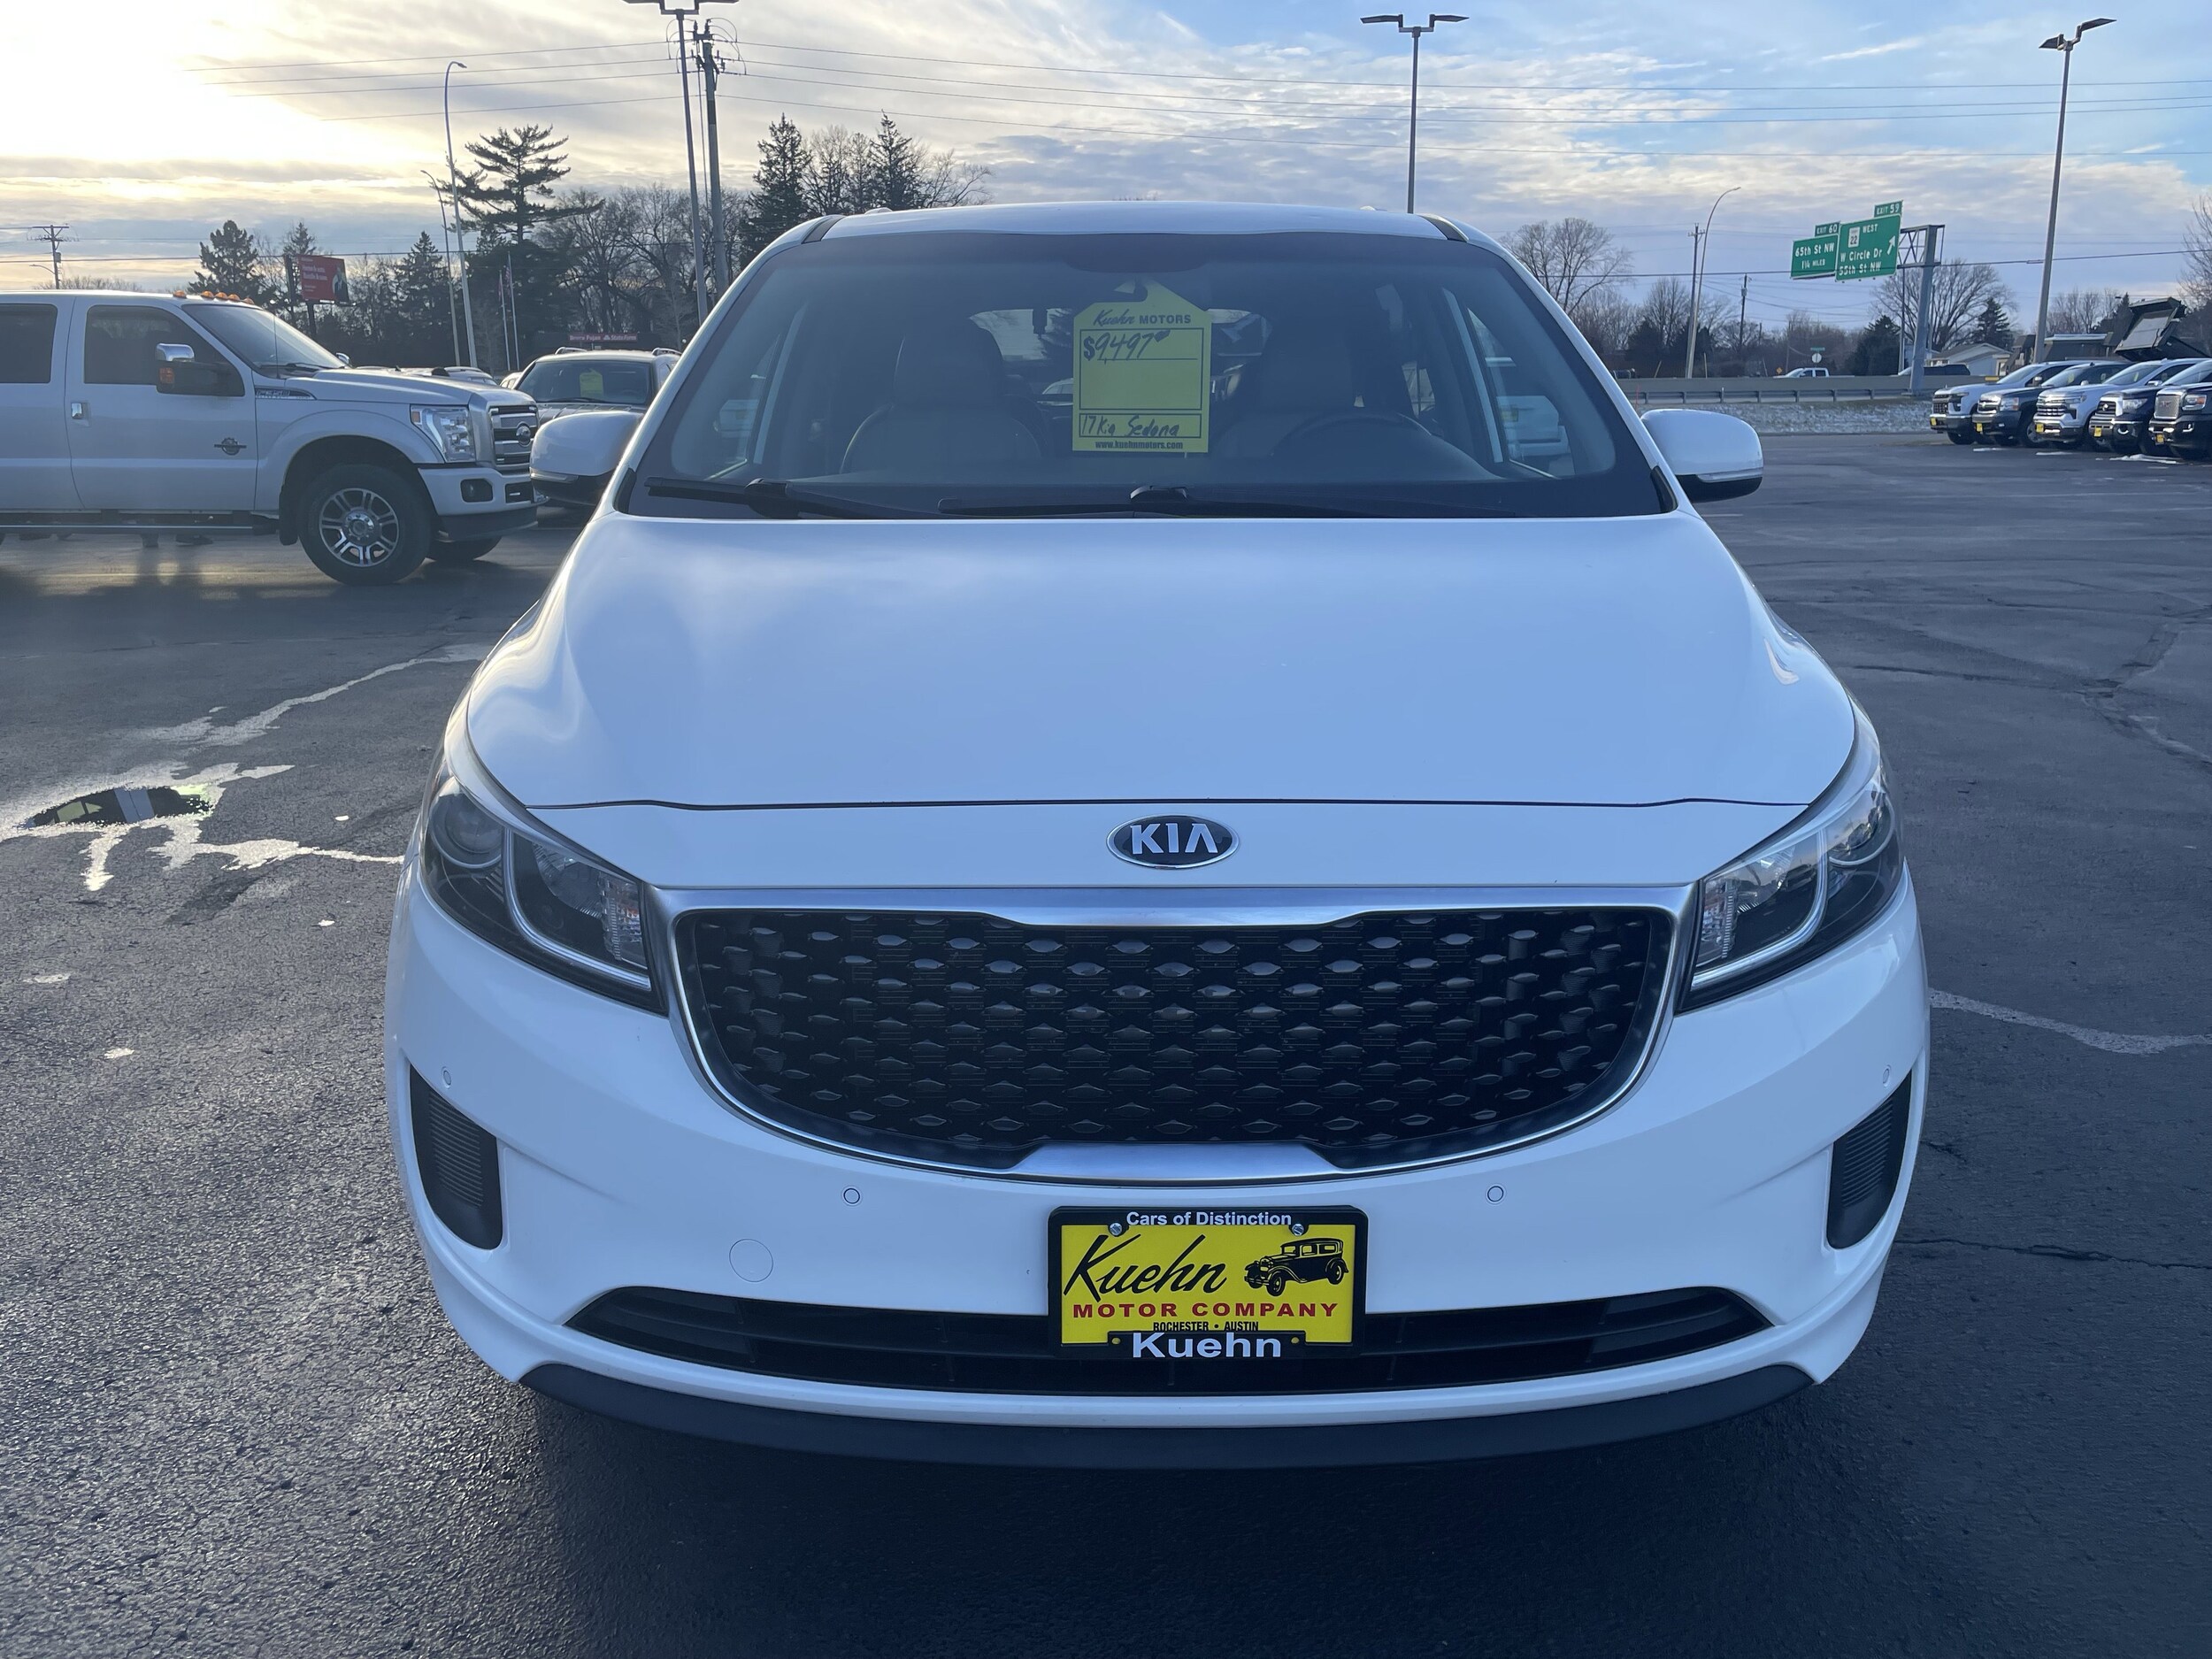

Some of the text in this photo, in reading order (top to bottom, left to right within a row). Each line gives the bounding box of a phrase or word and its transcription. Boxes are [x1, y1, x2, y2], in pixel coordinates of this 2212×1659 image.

[1877, 203, 1900, 215] EXIT 59
[1816, 224, 1838, 234] EXIT 60
[1863, 224, 1878, 234] WEST
[1850, 235, 1858, 245] 22
[1795, 242, 1834, 257] 65th St NW
[1840, 248, 1882, 261] W Circle Dr
[1812, 258, 1825, 267] MILES
[1839, 262, 1881, 276] 55th St NW
[1093, 309, 1191, 327] Kuehn MOTORS
[1082, 414, 1179, 437] 17 Kia Sedona
[1095, 441, 1183, 449] www.kuehnmotors.com
[1130, 823, 1218, 855] KIA
[1126, 1211, 1292, 1226] Cars of Distinction
[1064, 1233, 1227, 1303] Kuehn
[1072, 1302, 1339, 1318] MOTOR COMPANY
[1153, 1321, 1259, 1331] ROCHESTER AUSTIN
[1133, 1332, 1281, 1358] Kuehn
